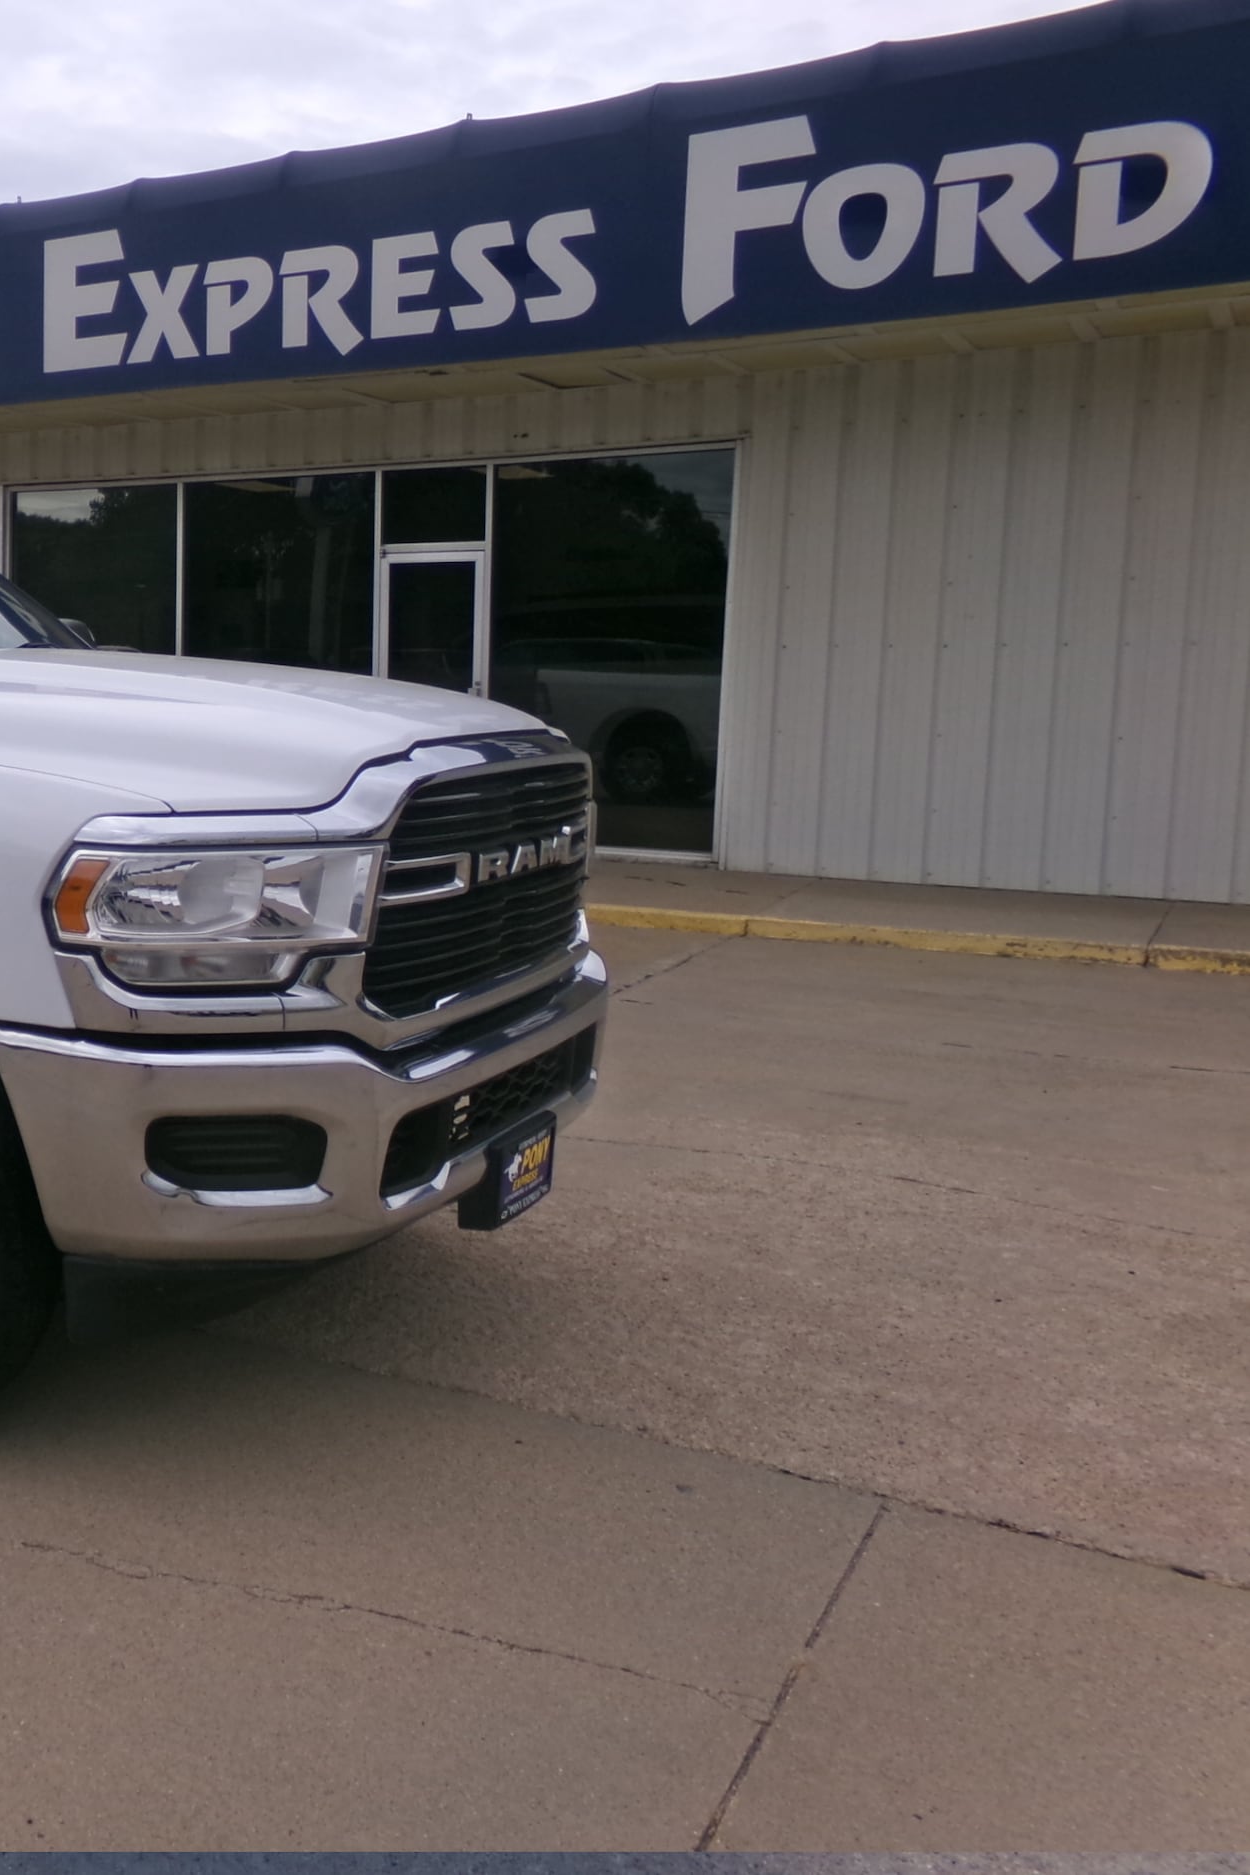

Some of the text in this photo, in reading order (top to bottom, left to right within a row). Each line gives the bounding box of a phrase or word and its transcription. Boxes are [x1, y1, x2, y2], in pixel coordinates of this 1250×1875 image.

[43, 208, 598, 374] EXPRESS
[681, 114, 1215, 327] FORD
[478, 833, 571, 882] RAM
